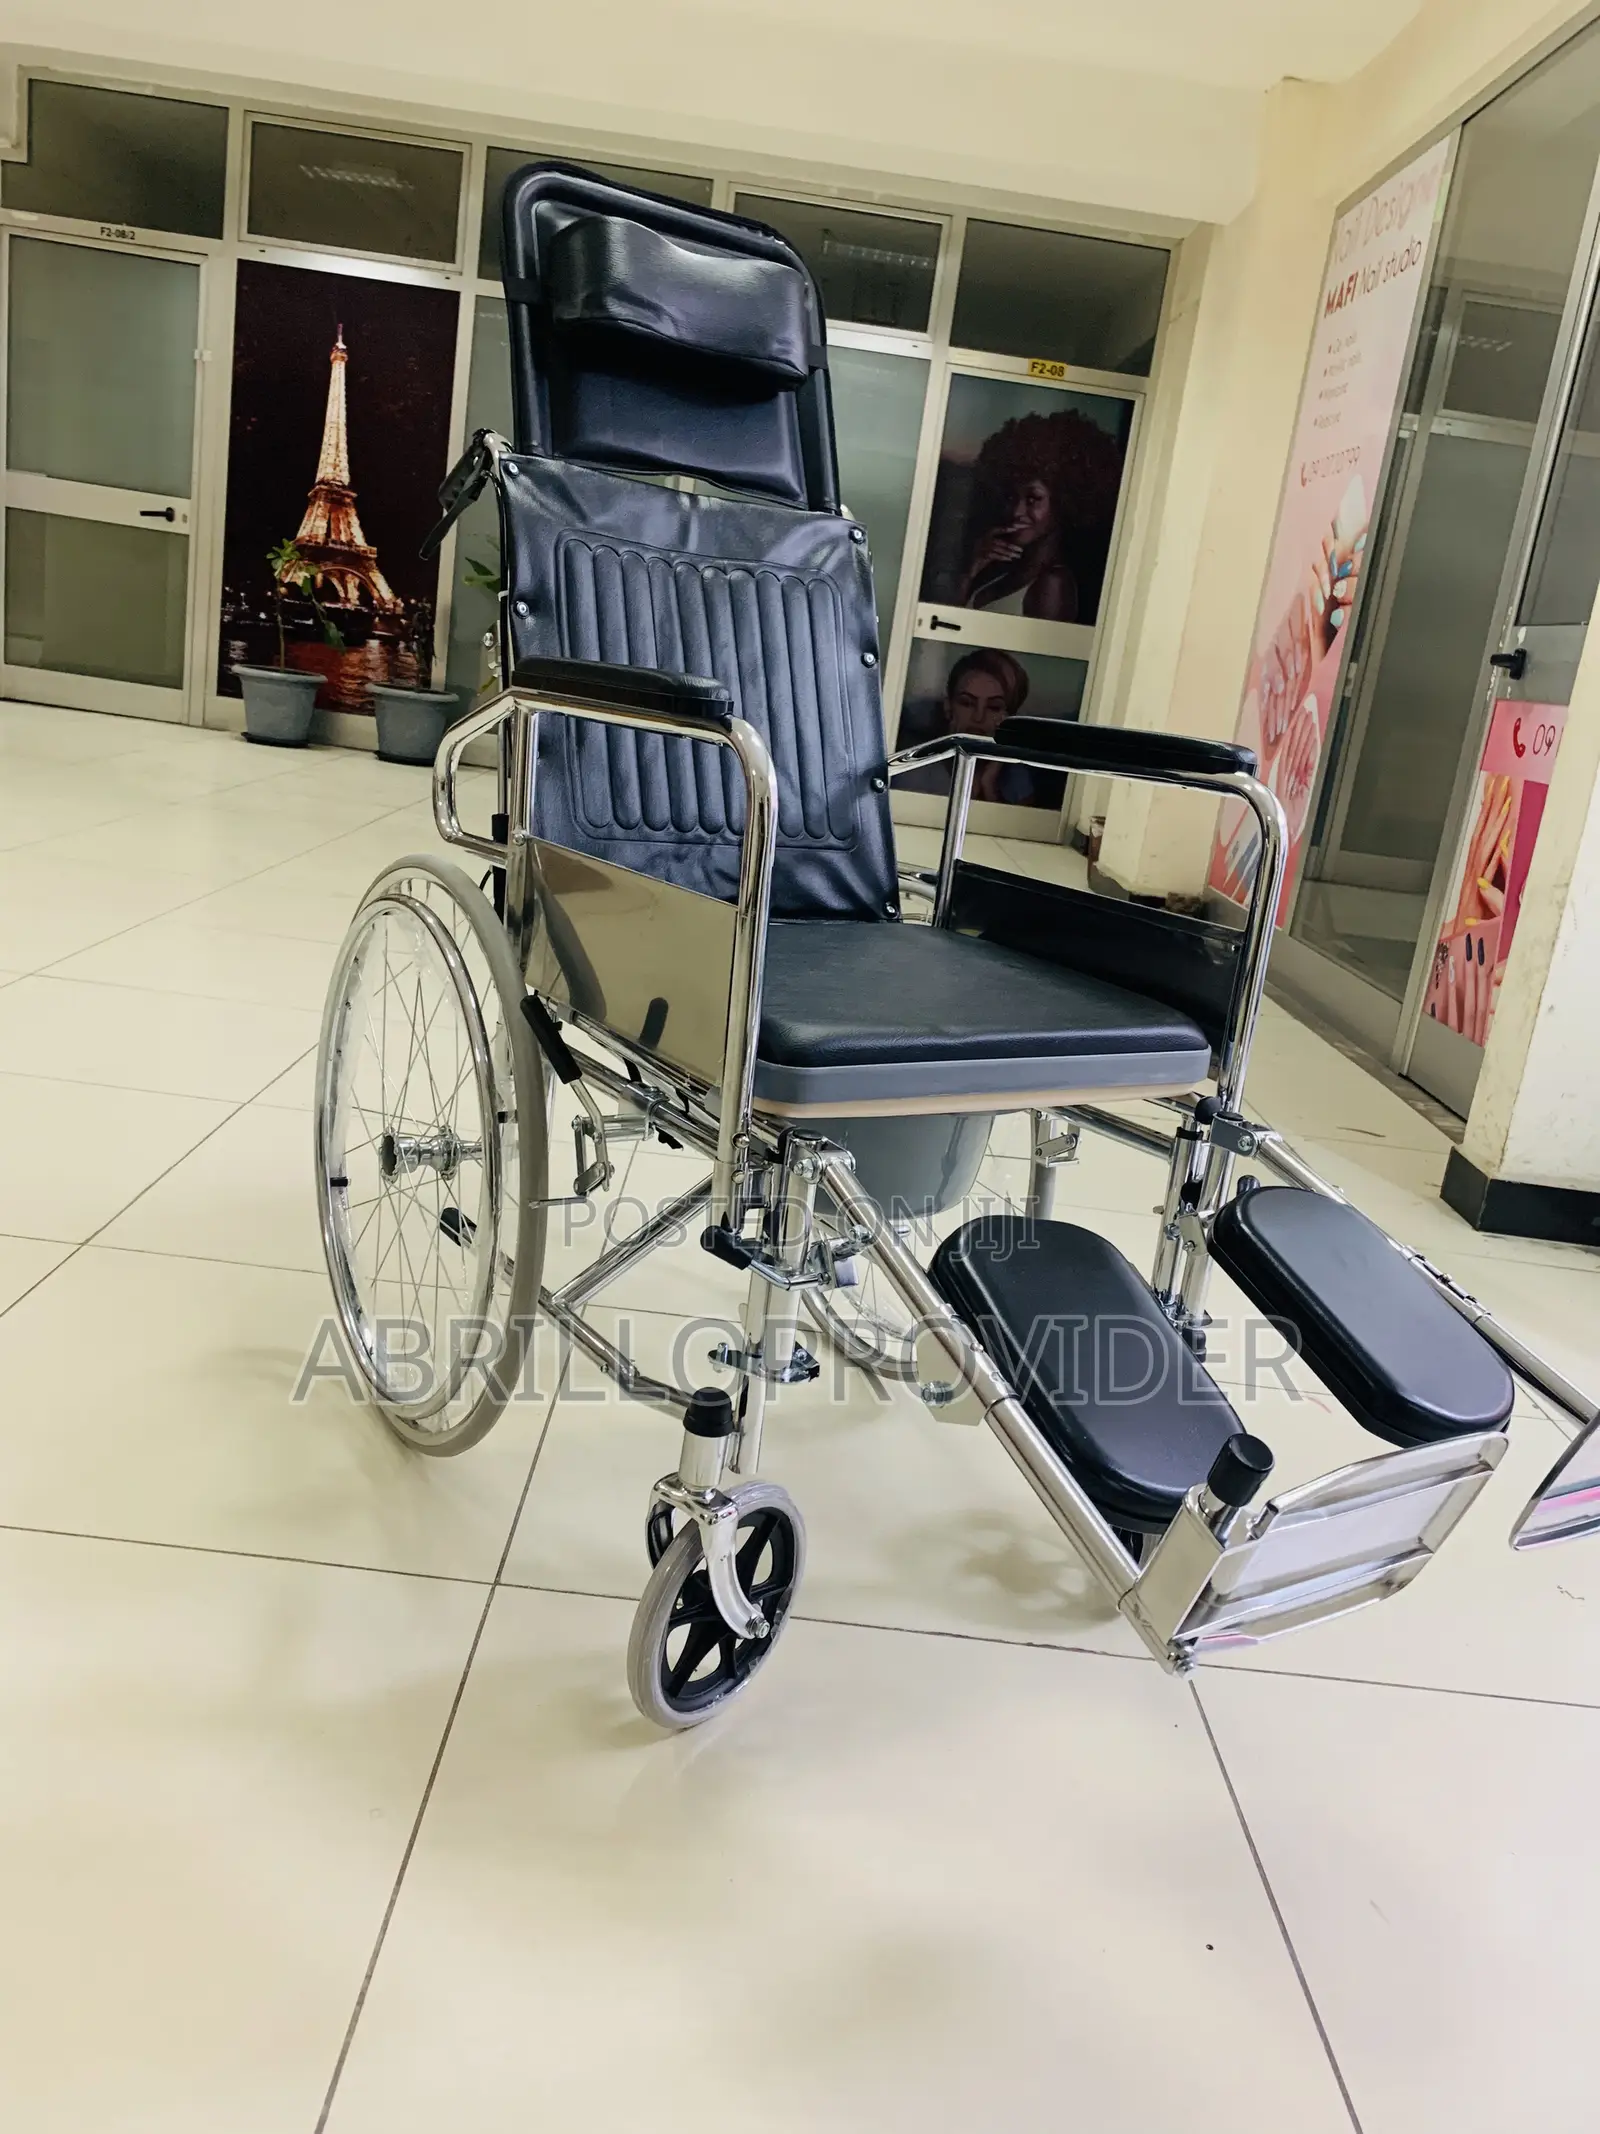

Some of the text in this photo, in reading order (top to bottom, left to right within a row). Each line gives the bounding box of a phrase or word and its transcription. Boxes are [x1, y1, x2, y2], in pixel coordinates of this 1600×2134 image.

[1324, 235, 1422, 318] MAFI Nail studio
[1030, 361, 1065, 377] F2-08
